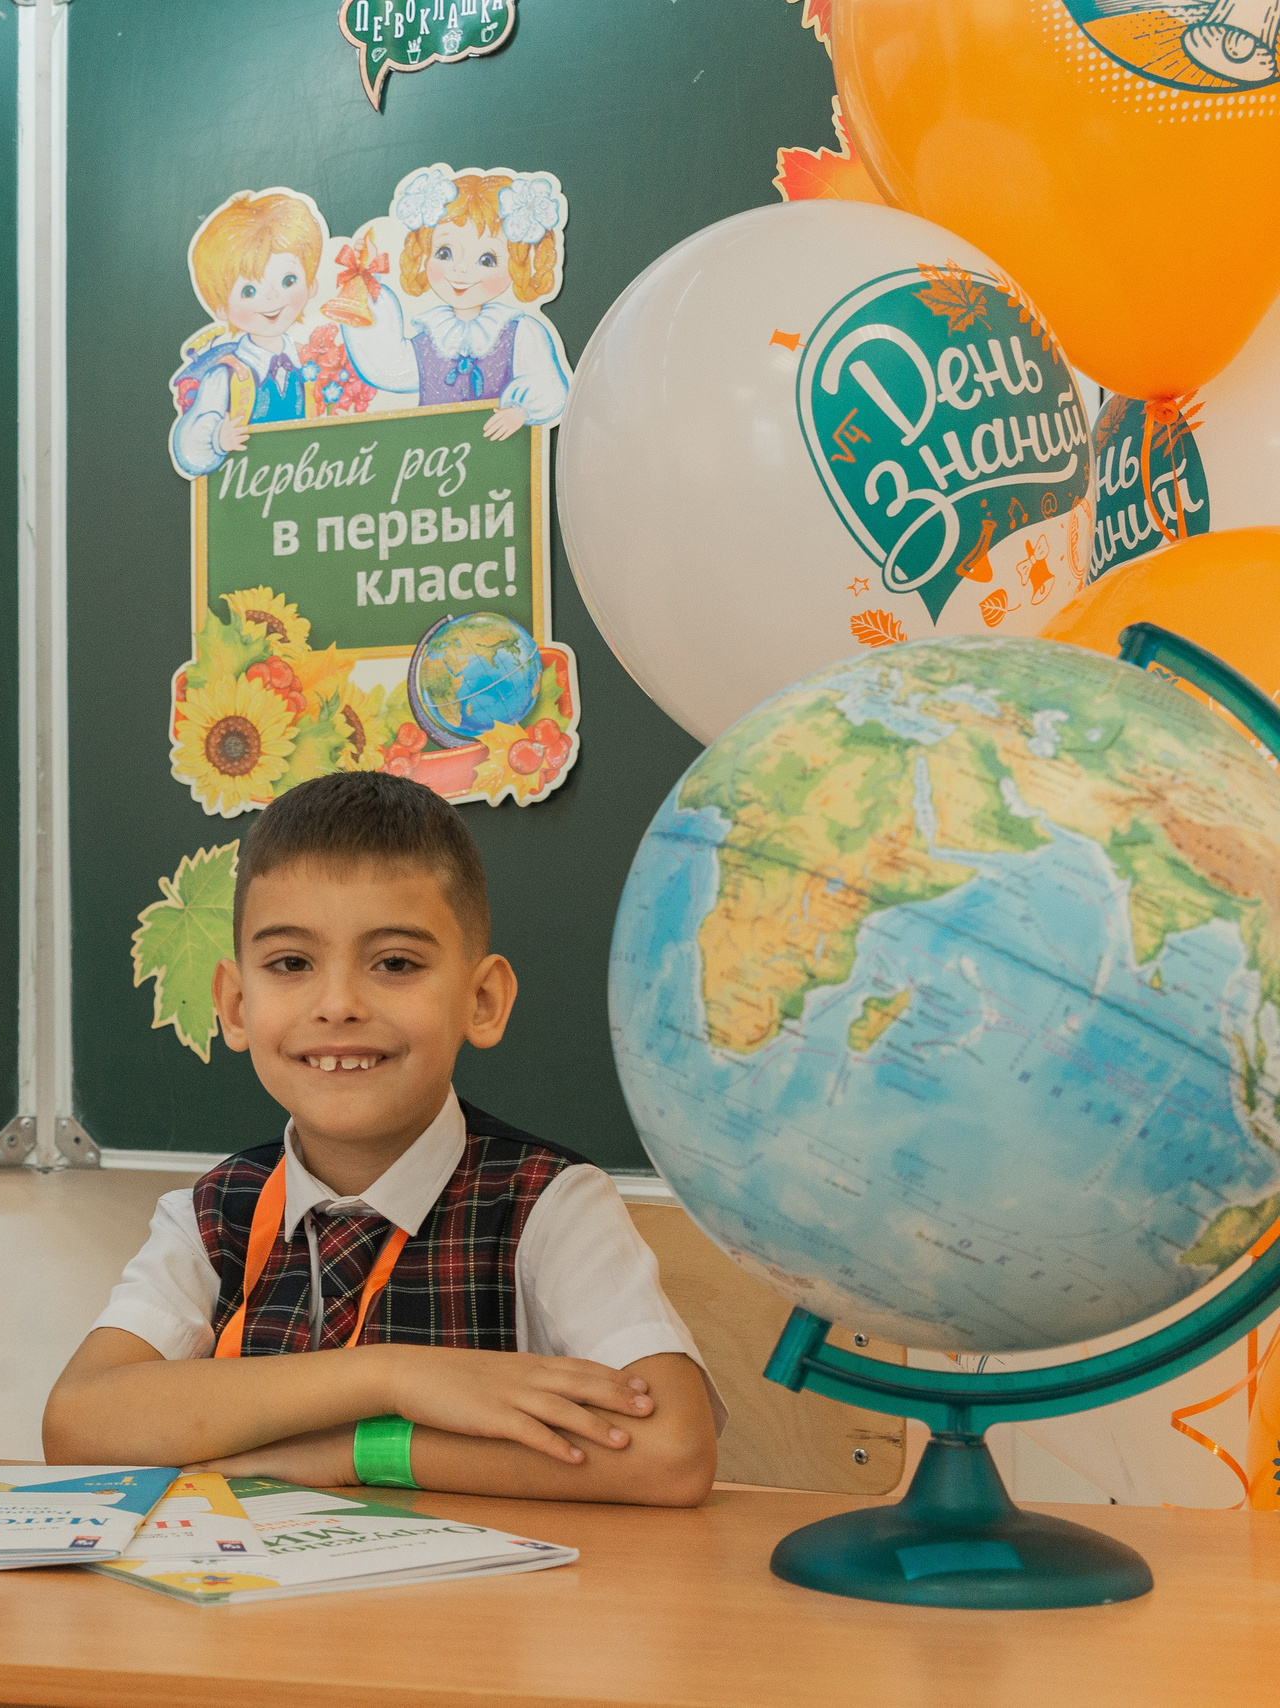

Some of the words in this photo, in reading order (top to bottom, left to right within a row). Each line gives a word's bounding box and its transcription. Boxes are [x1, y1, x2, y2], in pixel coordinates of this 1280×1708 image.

[821, 323, 1043, 446] День
[218, 440, 379, 518] Первый
[390, 441, 473, 504] раз
[864, 386, 1088, 593] Знаний
[1096, 436, 1139, 502] нь
[272, 519, 300, 556] в
[316, 488, 515, 561] первый
[356, 546, 519, 607] класс!
